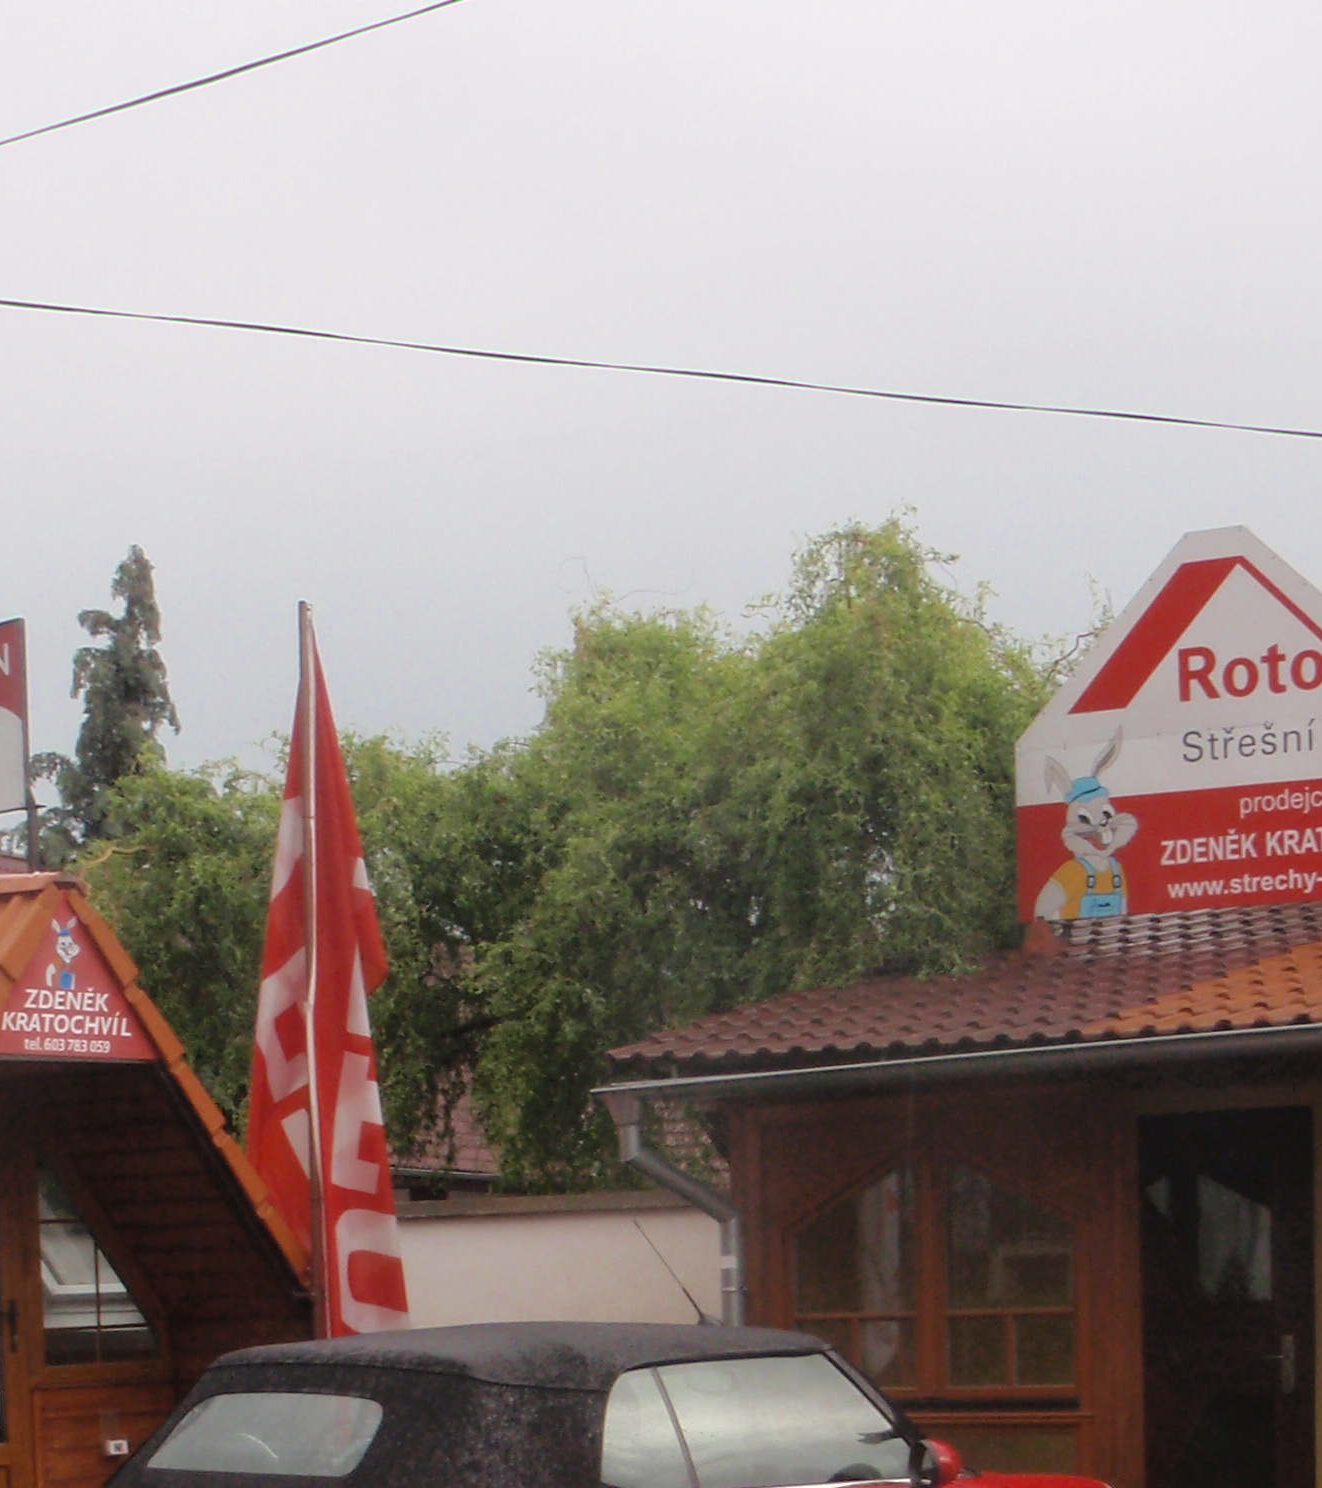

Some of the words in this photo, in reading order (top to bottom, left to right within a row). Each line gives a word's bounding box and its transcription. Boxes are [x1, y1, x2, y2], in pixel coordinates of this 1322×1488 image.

[1182, 717, 1315, 763] Střešní
[1160, 828, 1259, 866] ZDENĚK
[24, 987, 109, 1012] ZDENĚK
[1, 1012, 132, 1037] KRATOCHVÍL
[24, 1036, 43, 1051] tel.
[44, 1038, 66, 1052] 603
[67, 1039, 89, 1052] 783
[89, 1040, 111, 1053] 059
